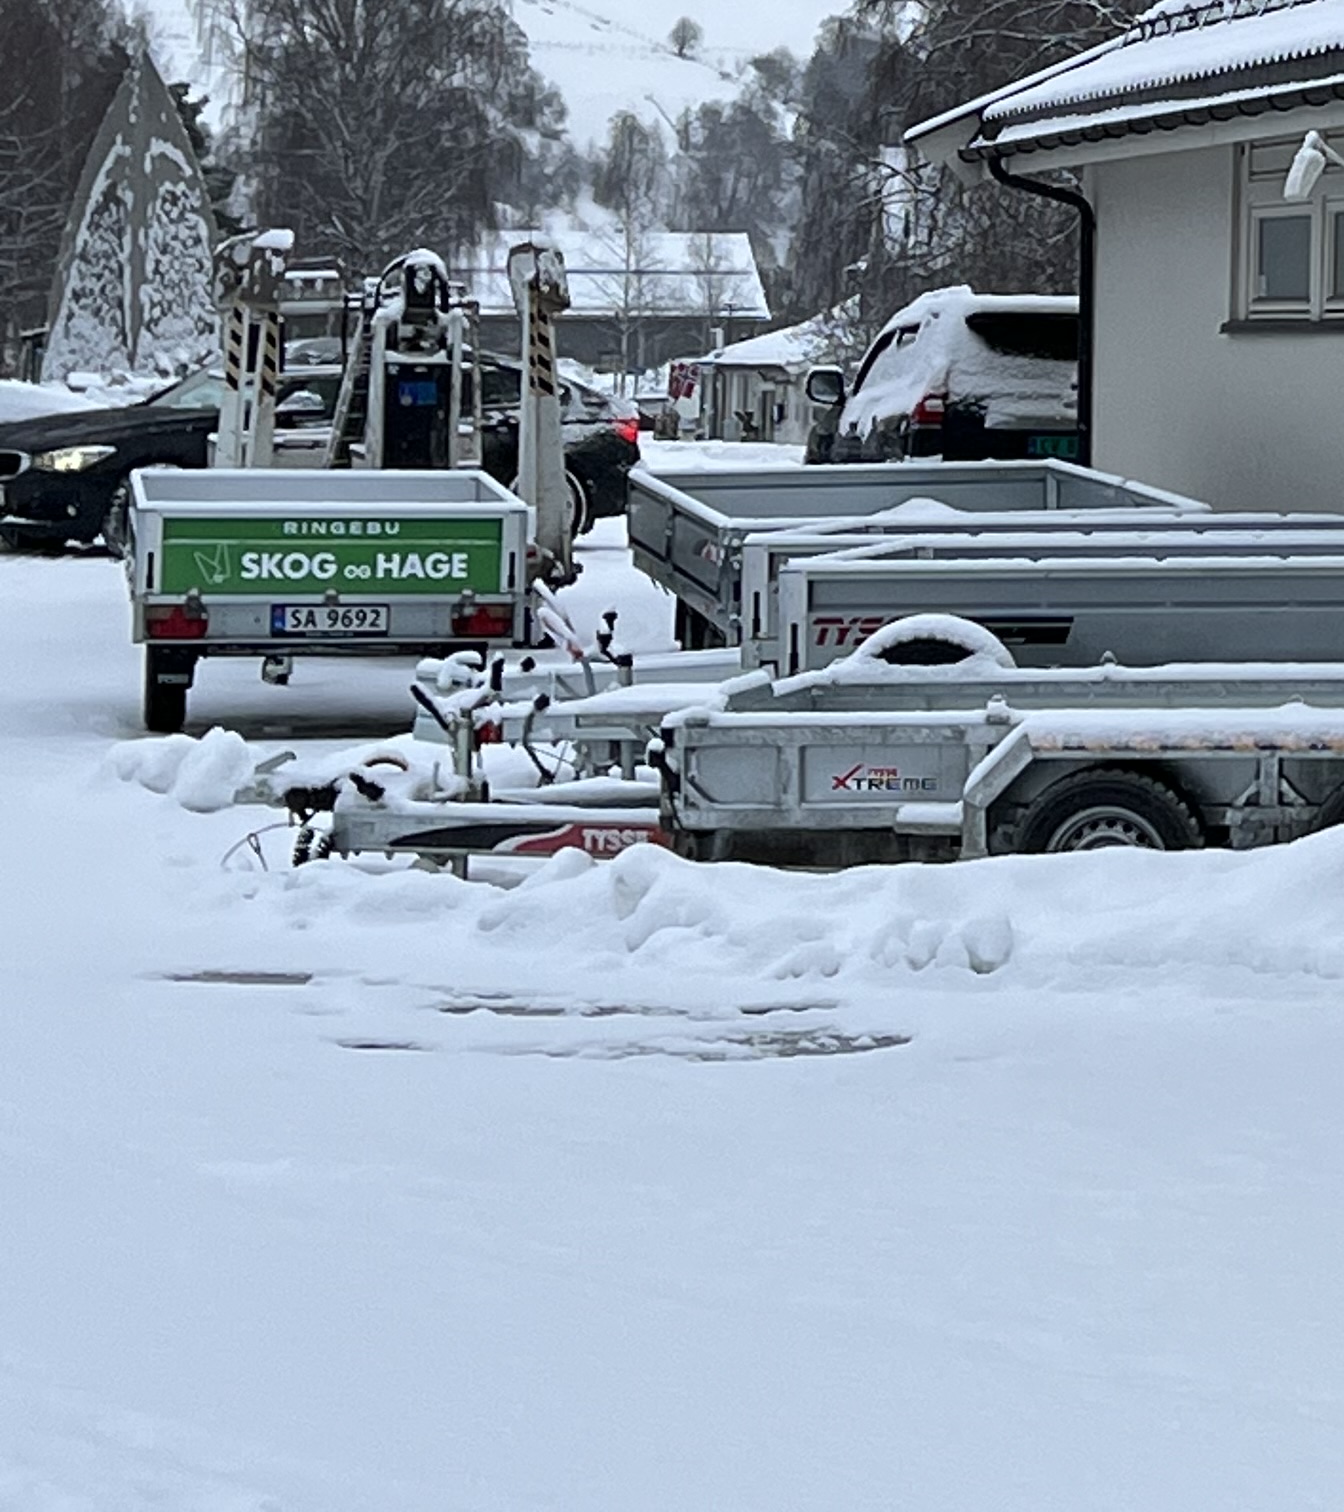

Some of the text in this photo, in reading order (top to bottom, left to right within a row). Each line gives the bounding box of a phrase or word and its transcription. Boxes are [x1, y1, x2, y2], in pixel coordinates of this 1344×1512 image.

[283, 521, 400, 535] RINGEBU
[240, 552, 338, 580] SKOG
[376, 552, 469, 580] HAGE
[290, 609, 381, 628] SA 9692
[812, 617, 885, 646] TYS
[831, 763, 938, 791] XTREME
